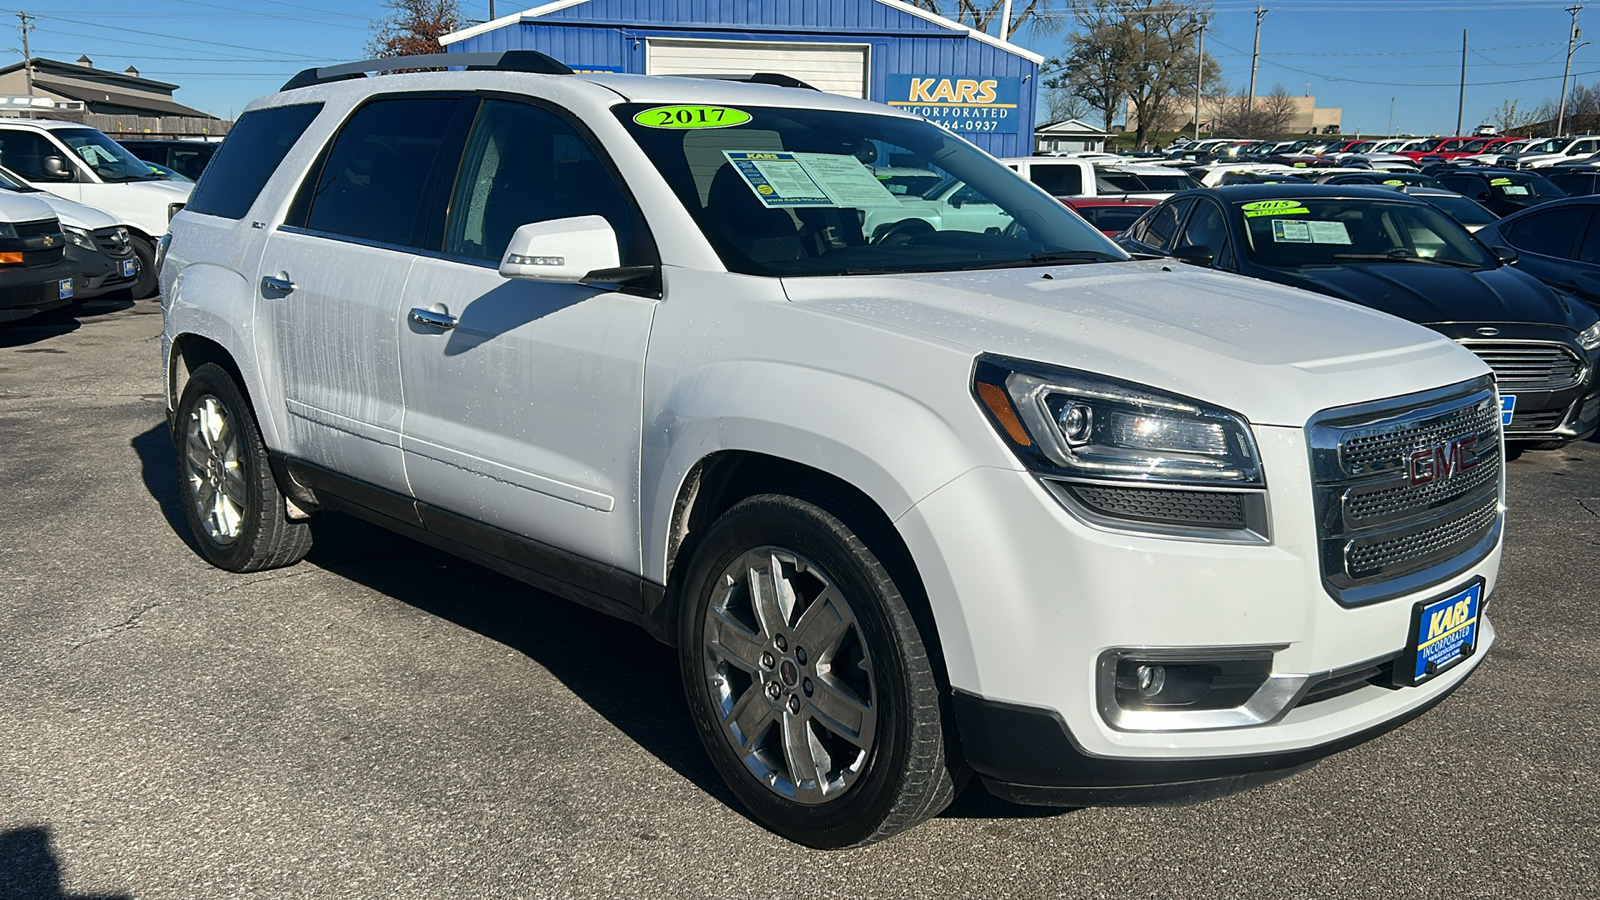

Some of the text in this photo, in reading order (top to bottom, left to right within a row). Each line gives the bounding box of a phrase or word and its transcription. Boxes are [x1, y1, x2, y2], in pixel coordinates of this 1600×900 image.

[909, 78, 998, 103] KARS
[656, 108, 726, 126] 2017
[897, 106, 1009, 119] NCORPORATED
[1253, 201, 1290, 210] 2015
[1407, 433, 1478, 486] GMC
[1427, 596, 1471, 640] KARS
[1422, 626, 1470, 659] INCORPORATED
